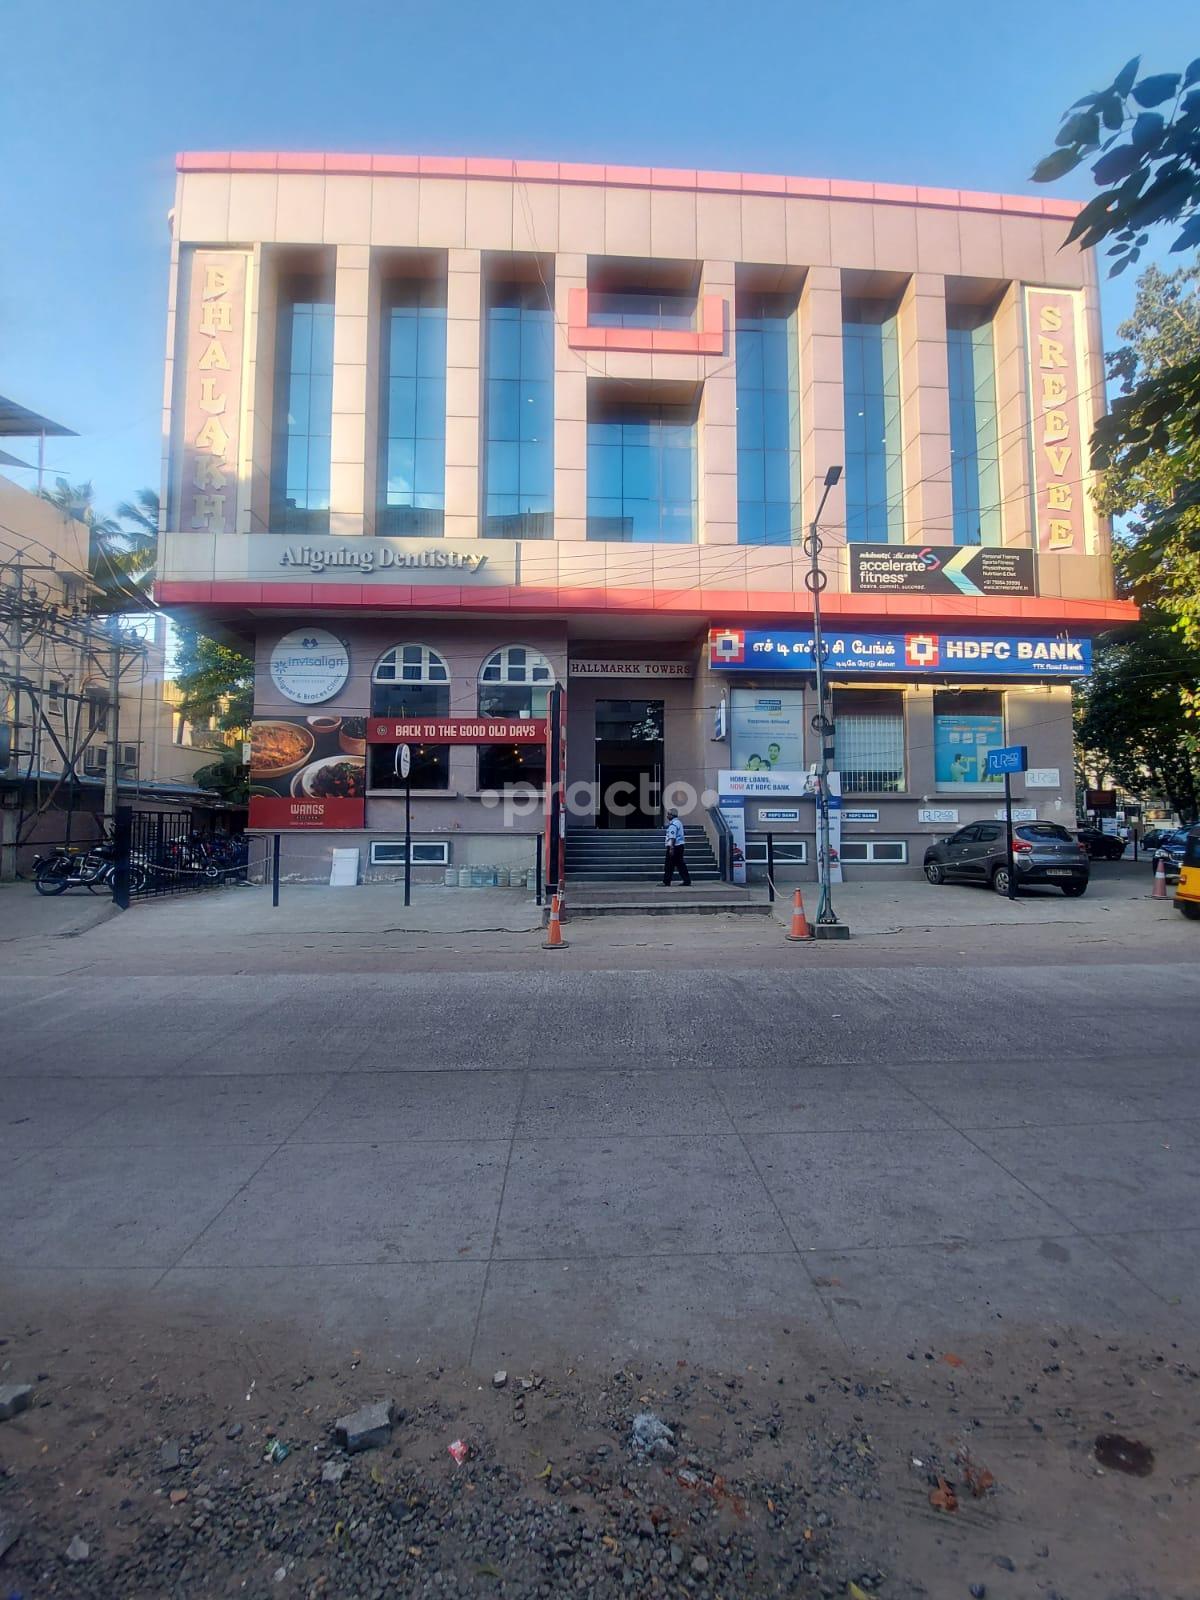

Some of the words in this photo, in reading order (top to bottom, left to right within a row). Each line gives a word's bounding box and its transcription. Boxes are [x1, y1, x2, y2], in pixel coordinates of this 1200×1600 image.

[1038, 306, 1074, 550] SREEVEE
[279, 545, 374, 574] Aligning
[378, 547, 489, 574] Dentistry
[859, 560, 926, 572] accelerate
[752, 639, 773, 653] எச்
[777, 641, 789, 656] டி
[832, 640, 844, 654] சி
[852, 640, 896, 655] பேங்க்
[946, 640, 1010, 659] HDFC
[1018, 642, 1083, 661] BANK
[288, 656, 343, 669] invisalign
[571, 663, 640, 673] HALLMARKK
[645, 664, 689, 674] TOWERS
[395, 725, 421, 737] BACK
[424, 725, 435, 737] TO
[438, 725, 457, 737] THE
[459, 725, 486, 737] GOOD
[488, 725, 507, 737] OLD
[509, 725, 536, 737] DAYS
[290, 804, 325, 815] WANGS
